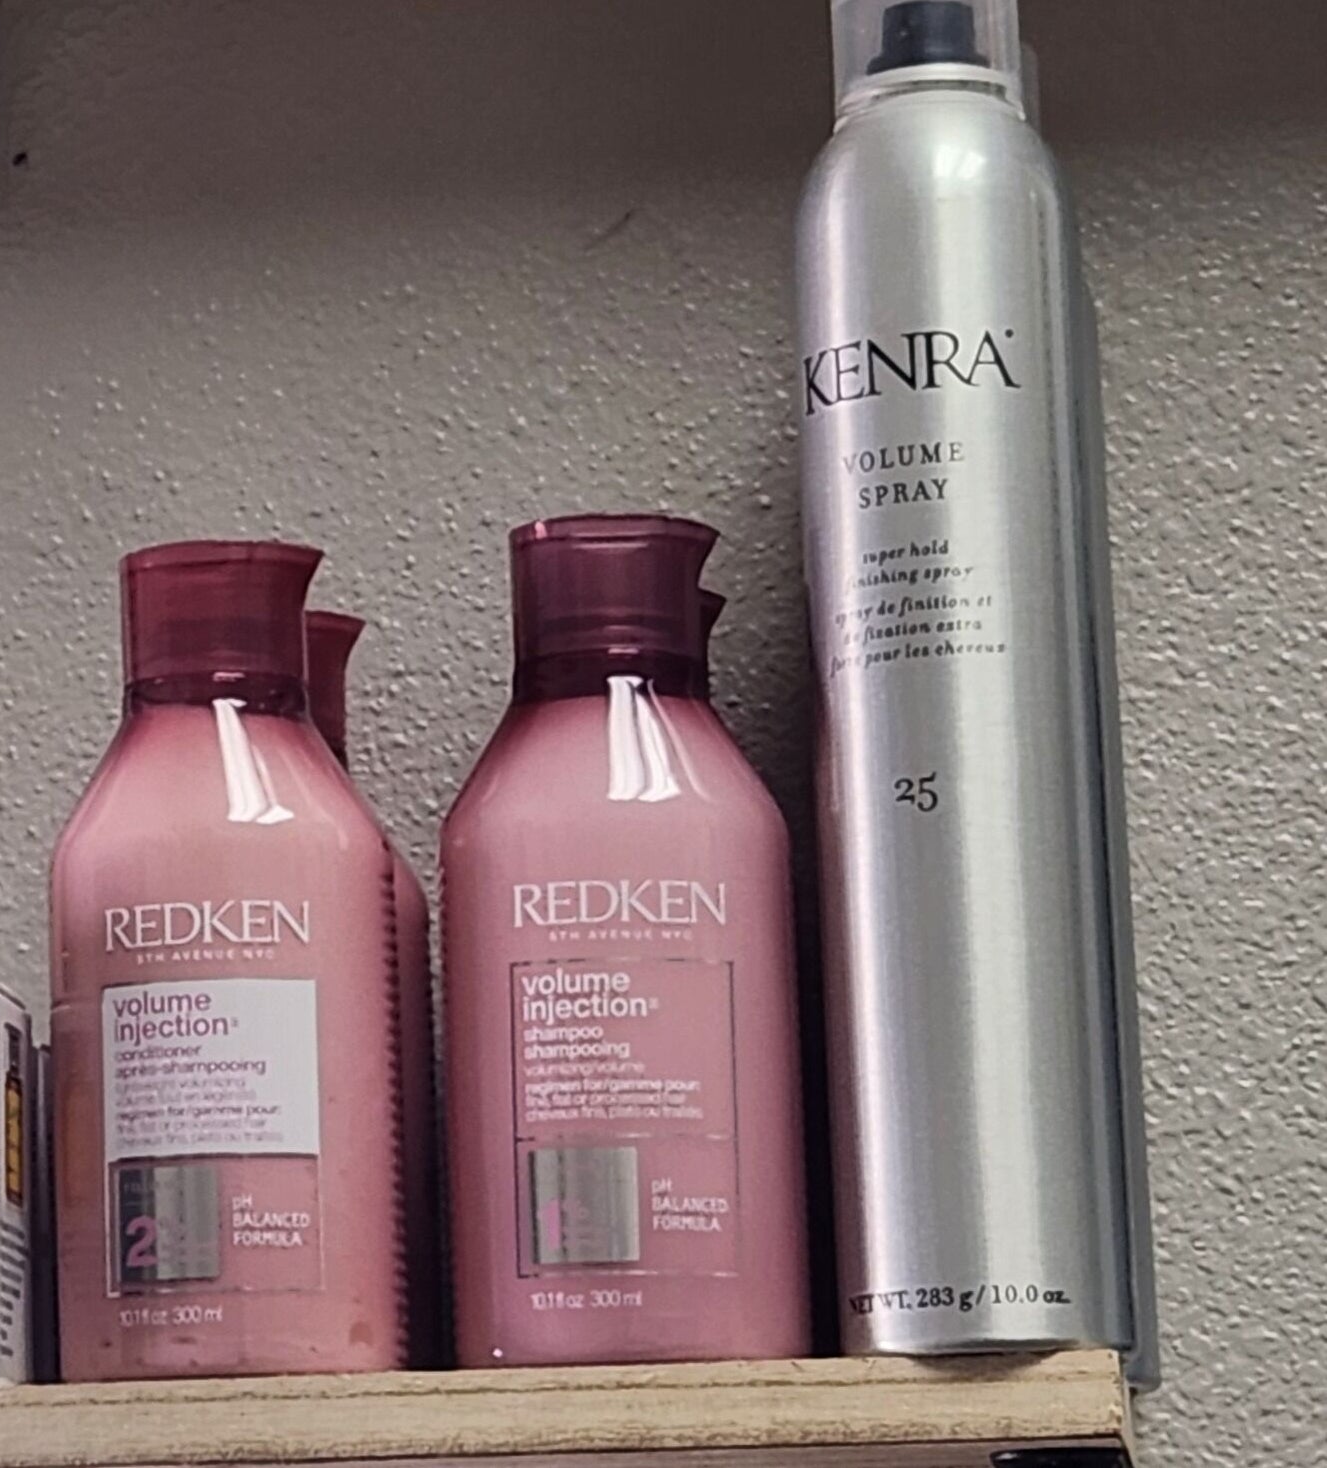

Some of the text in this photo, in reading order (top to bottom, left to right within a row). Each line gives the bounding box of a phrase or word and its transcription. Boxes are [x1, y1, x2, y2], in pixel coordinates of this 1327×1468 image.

[803, 330, 1021, 416] KENRA
[843, 442, 965, 475] VOLUME
[859, 478, 948, 509] SPRAY
[910, 540, 949, 557] hold
[847, 566, 974, 594] nishing spray
[936, 620, 982, 634] extra
[865, 649, 901, 669] pour
[905, 643, 929, 658] les
[895, 772, 938, 811] 25
[513, 880, 726, 928] REDKEN
[105, 900, 310, 951] REDKEN
[588, 930, 653, 940] AVENUE
[662, 930, 693, 940] NYC
[522, 968, 630, 996] volume
[113, 991, 212, 1018] volume
[523, 1026, 603, 1042] shampoo
[116, 1045, 201, 1062] conditioner
[524, 1042, 630, 1060] shampooing
[652, 1177, 671, 1194] pH
[232, 1195, 254, 1209] pH
[652, 1197, 729, 1213] BALANCED
[233, 1212, 310, 1229] BALANCED
[653, 1215, 722, 1232] FORMULA
[126, 1215, 158, 1268] 2
[233, 1230, 303, 1247] FORMULA
[567, 1293, 584, 1308] oz
[590, 1290, 621, 1307] 300
[623, 1291, 643, 1307] ml
[916, 1287, 955, 1309] 283
[992, 1284, 1039, 1304] 10.0
[152, 1310, 168, 1325] oz
[173, 1306, 202, 1324] 300
